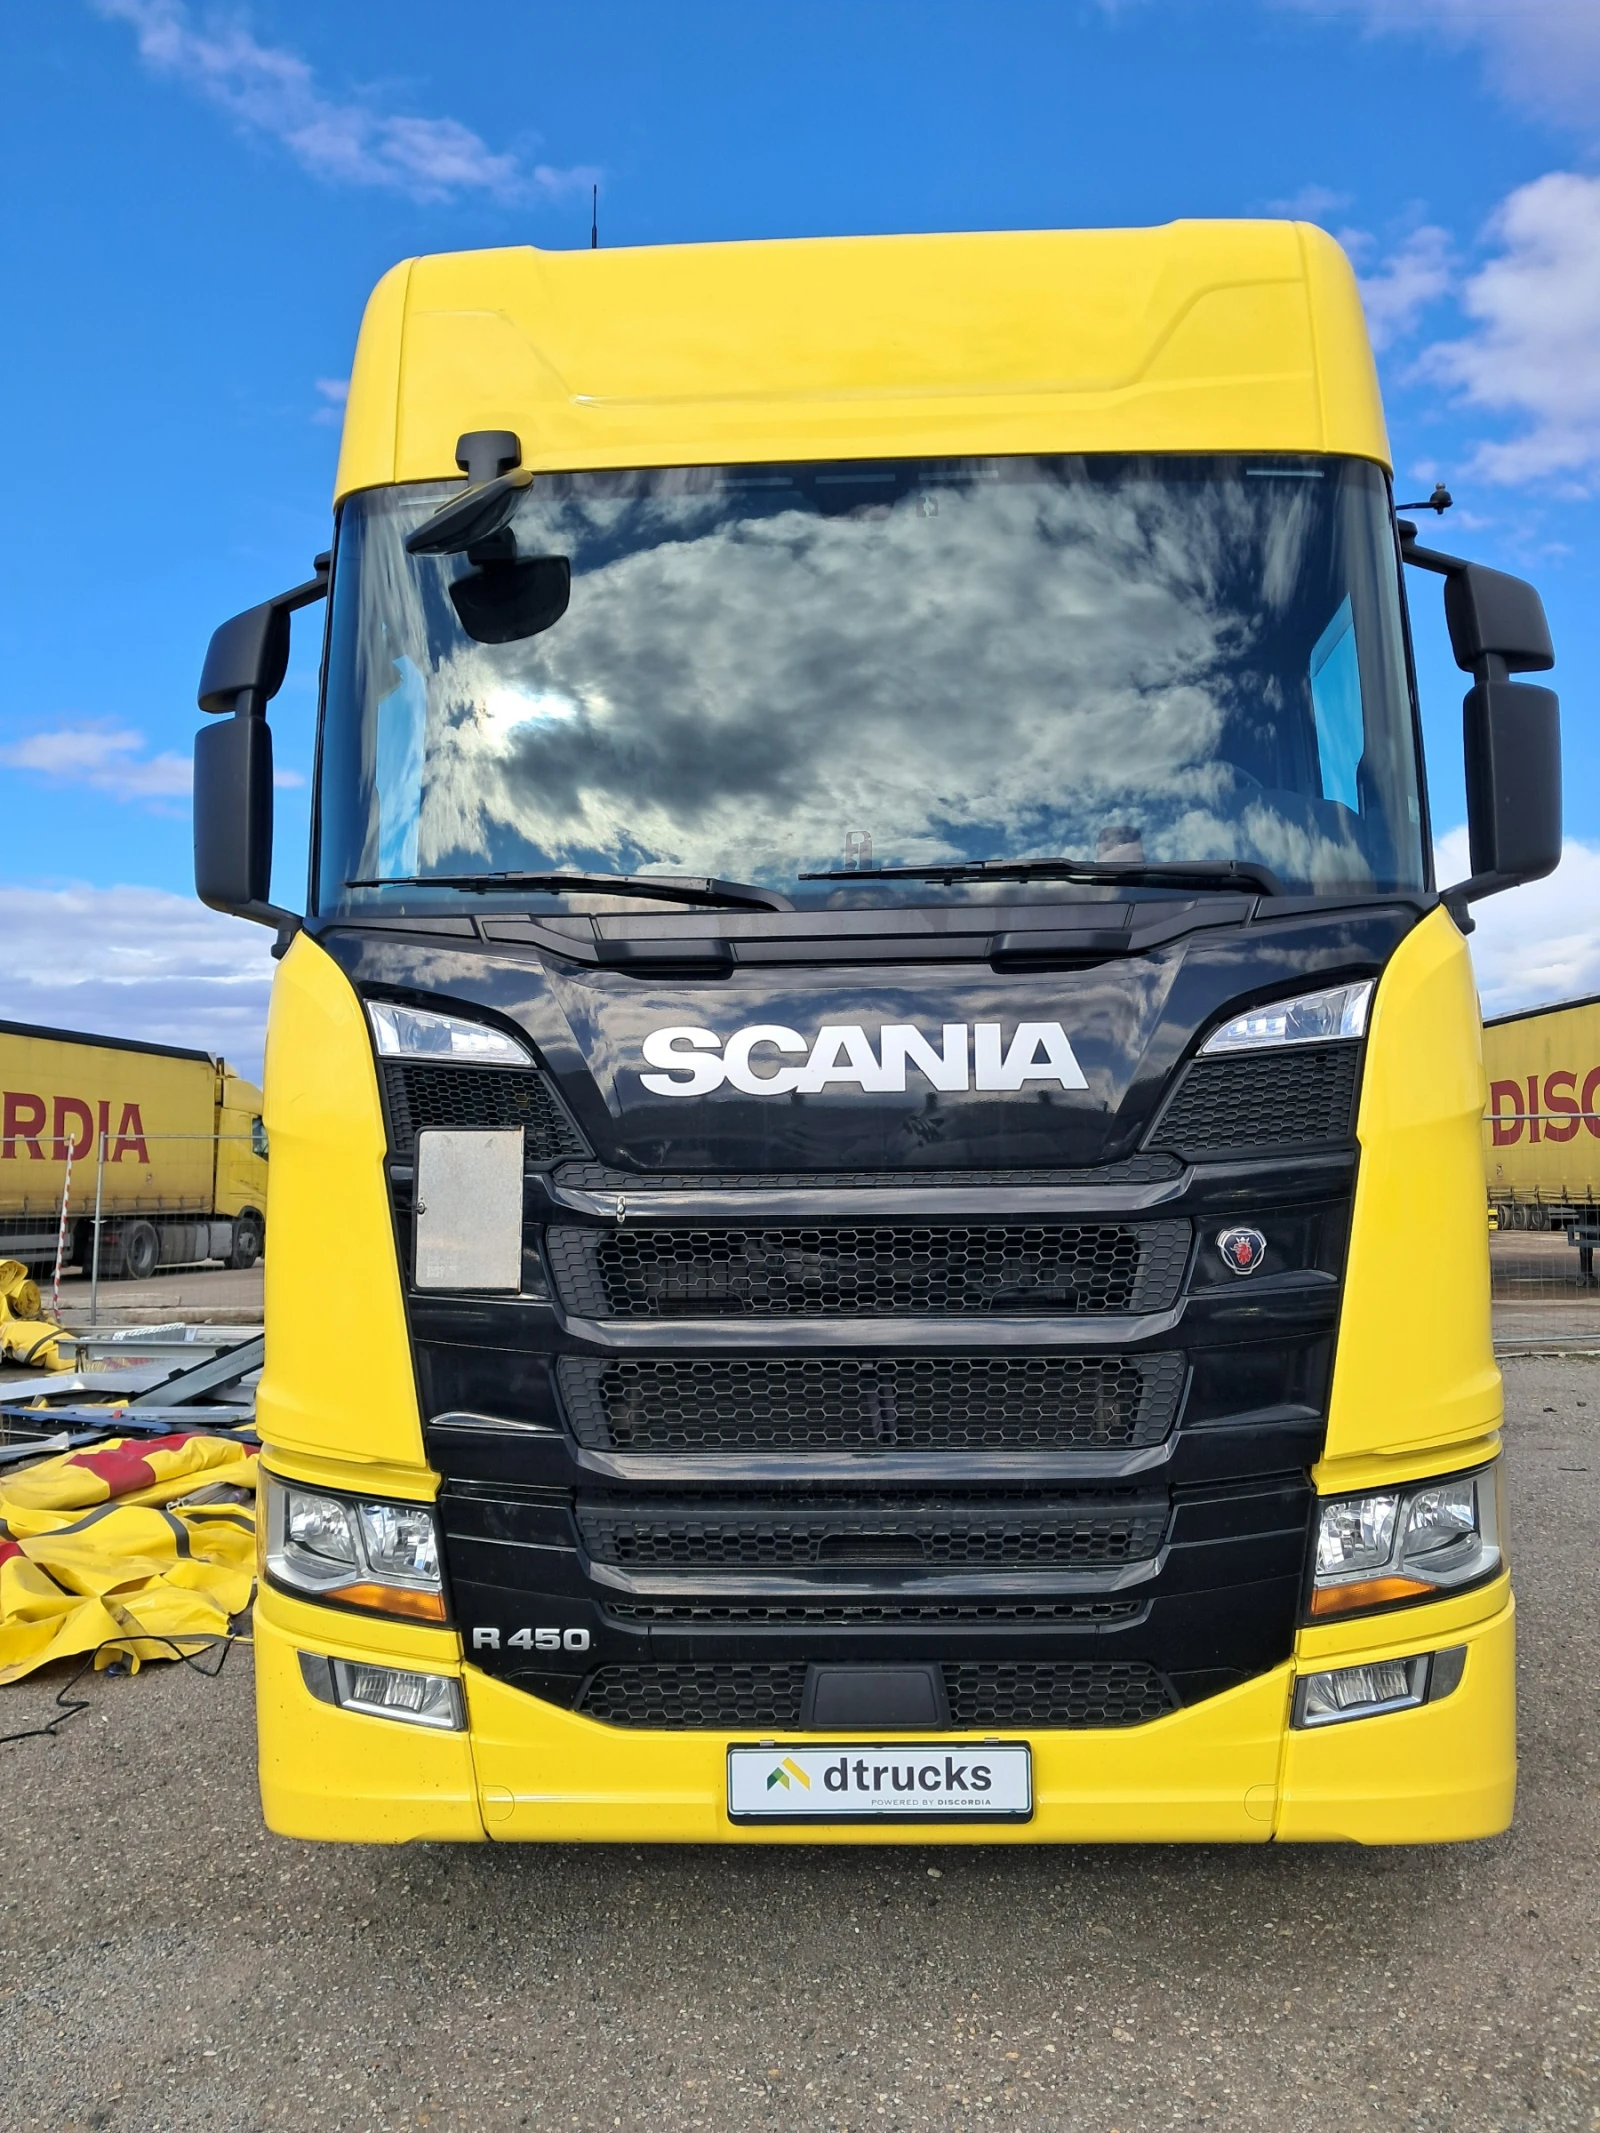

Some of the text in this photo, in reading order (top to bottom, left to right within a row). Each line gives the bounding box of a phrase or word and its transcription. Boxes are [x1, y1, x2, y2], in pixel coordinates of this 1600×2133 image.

[639, 1021, 1090, 1096] SCANIA
[472, 1627, 590, 1651] R 450
[823, 1757, 992, 1791] dtrucks
